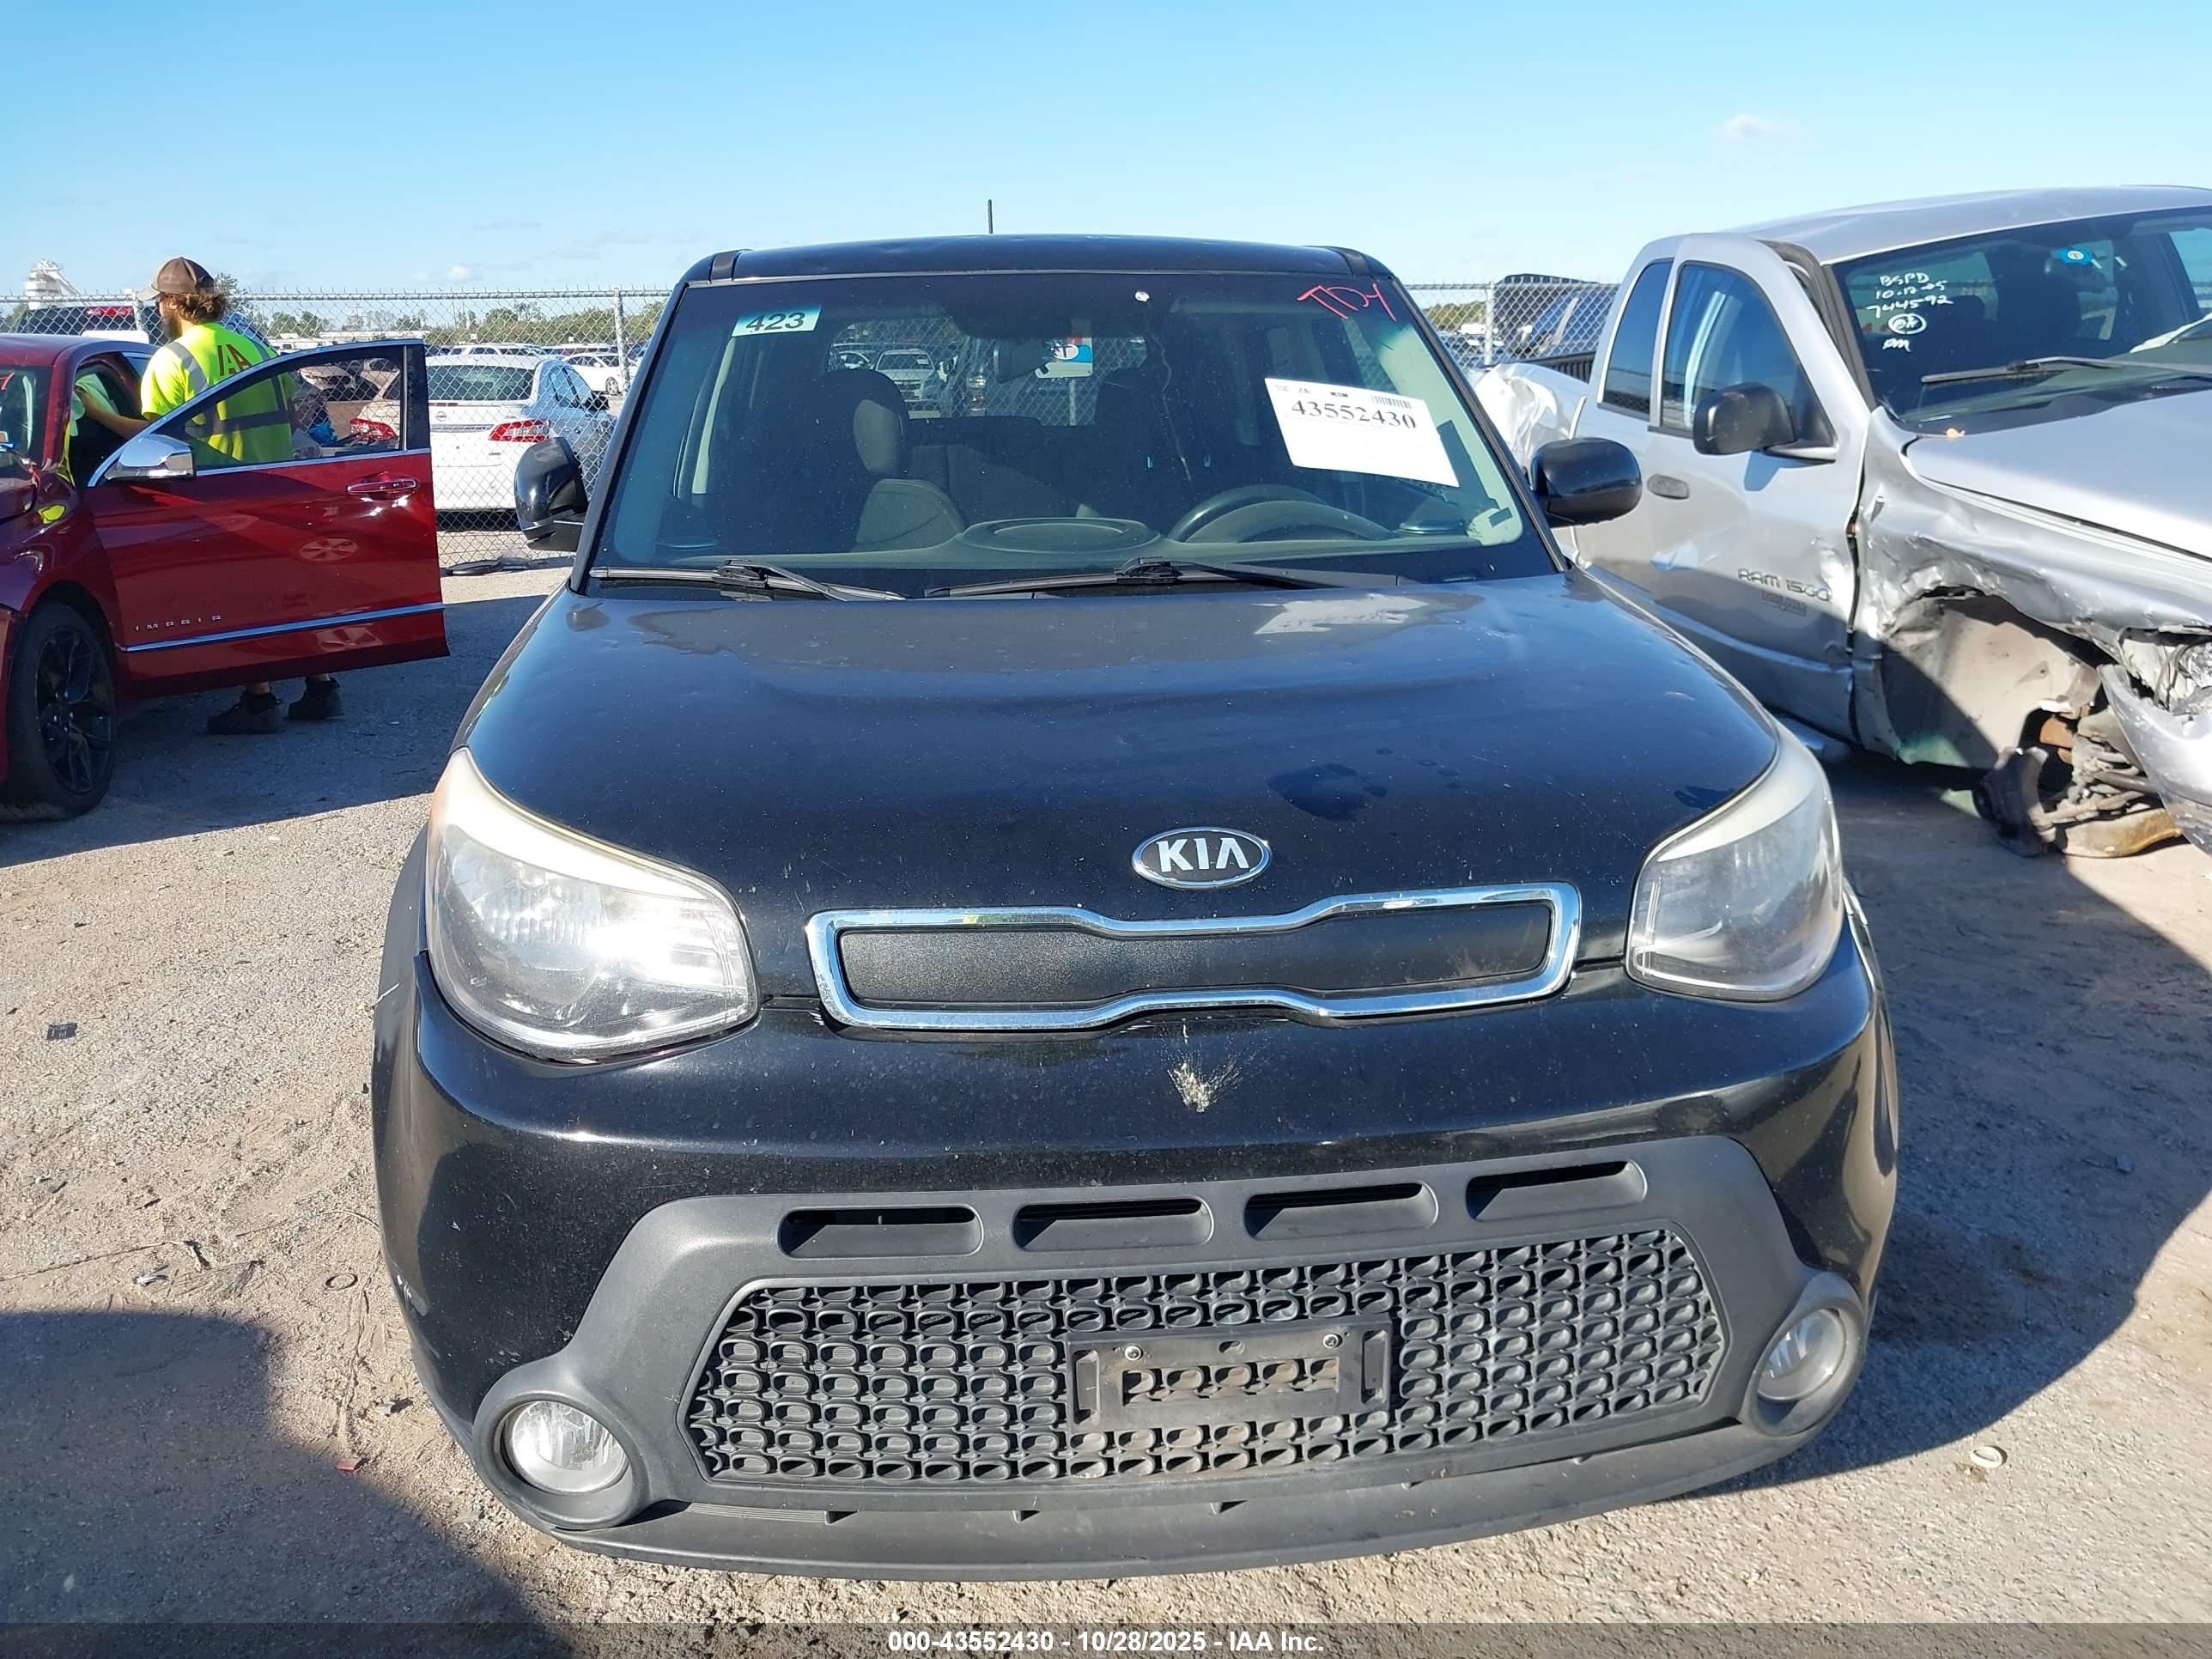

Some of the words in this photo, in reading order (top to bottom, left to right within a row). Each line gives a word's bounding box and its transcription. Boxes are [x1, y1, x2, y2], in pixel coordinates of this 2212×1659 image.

[744, 312, 806, 332] 423
[1291, 399, 1418, 429] 43552430
[1737, 568, 1781, 589] RAM
[1785, 579, 1833, 603] 1500
[1156, 836, 1250, 873] KIA
